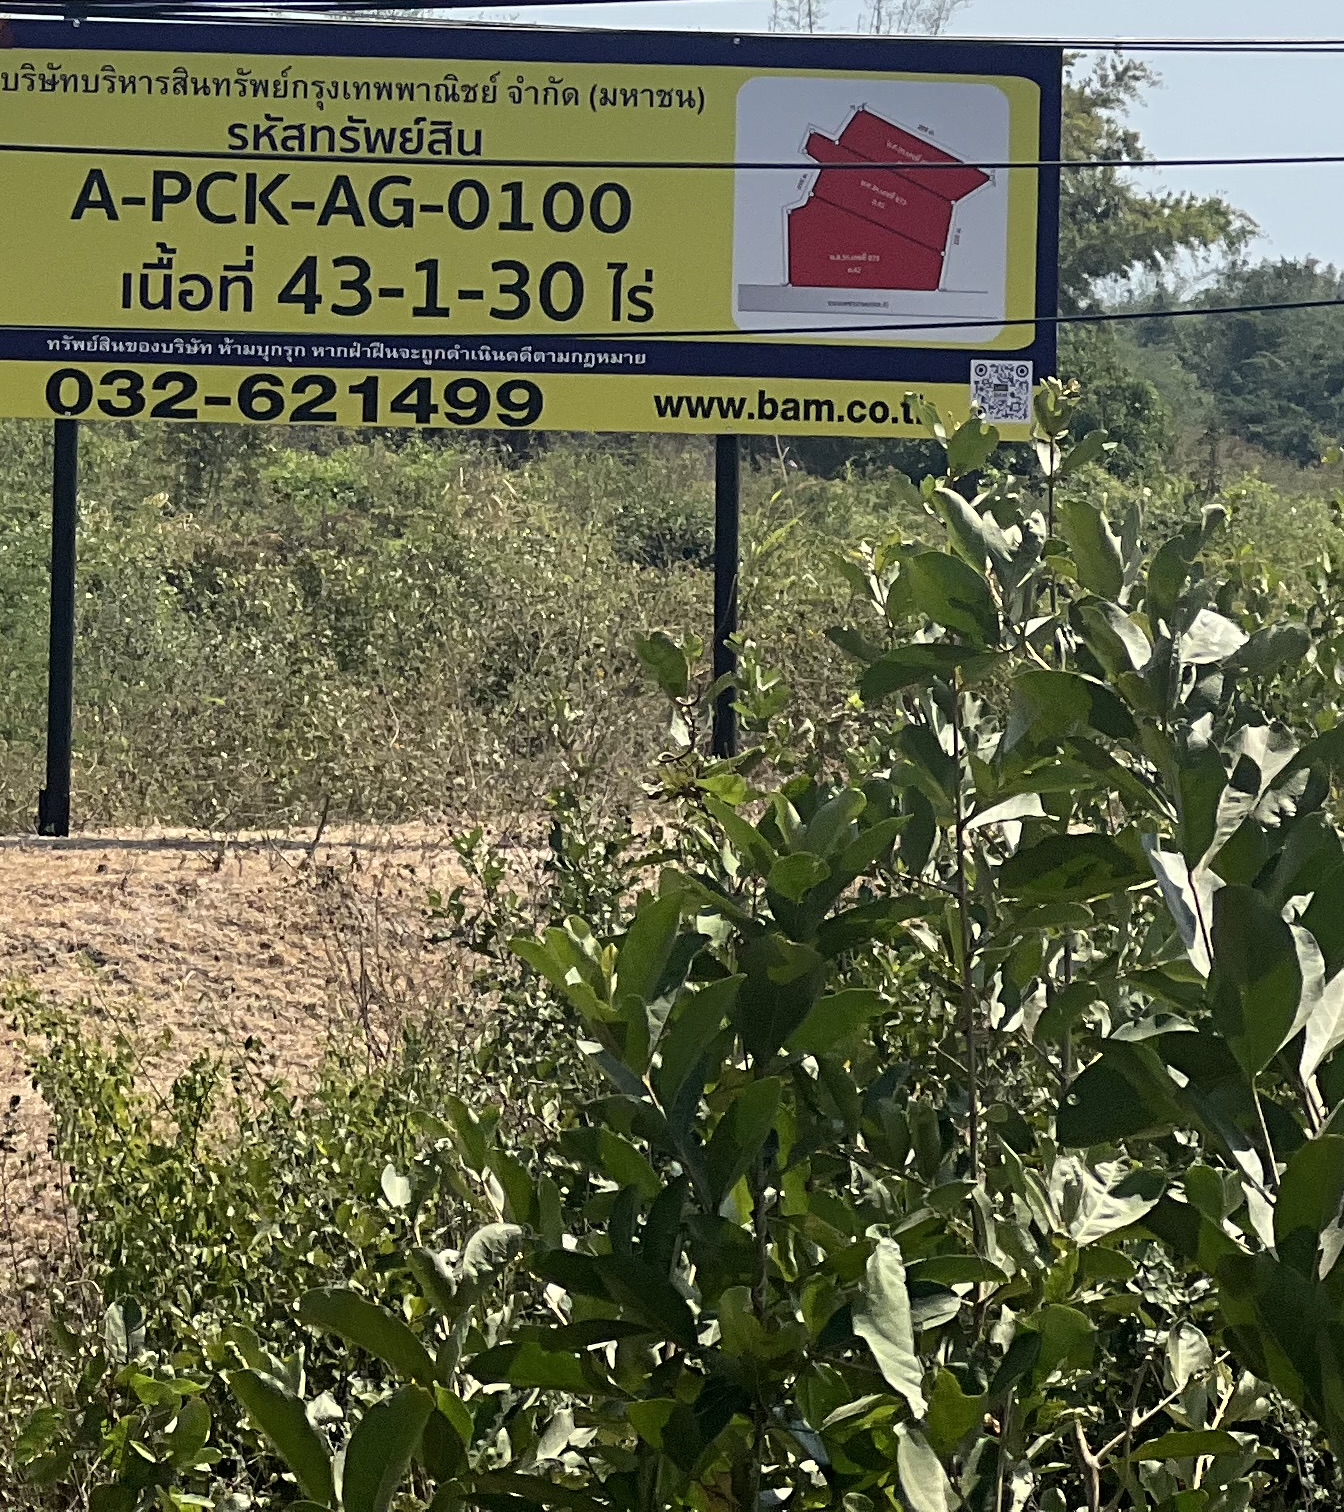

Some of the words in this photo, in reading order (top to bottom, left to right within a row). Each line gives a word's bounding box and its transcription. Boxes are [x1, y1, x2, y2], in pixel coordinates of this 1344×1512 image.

[0, 62, 501, 110] บริษัทบริหารสินทรัพย์กรุงเทพพาณิชย์
[508, 75, 580, 107] จำกัด
[589, 83, 706, 115] (มหาชน)
[227, 113, 482, 157] รหัสทรัพย์สิน
[70, 168, 632, 234] A-PCK-AG-0100
[121, 241, 254, 313] เนื้อที่
[277, 255, 584, 322] 43-1-30
[606, 262, 654, 323] ไร่
[46, 335, 212, 355] ทรัพย์สินของบริษัท
[218, 337, 306, 363] ห้ามบุกรุก
[45, 368, 544, 427] 032-621499
[653, 389, 925, 425] www.bam.co.t
